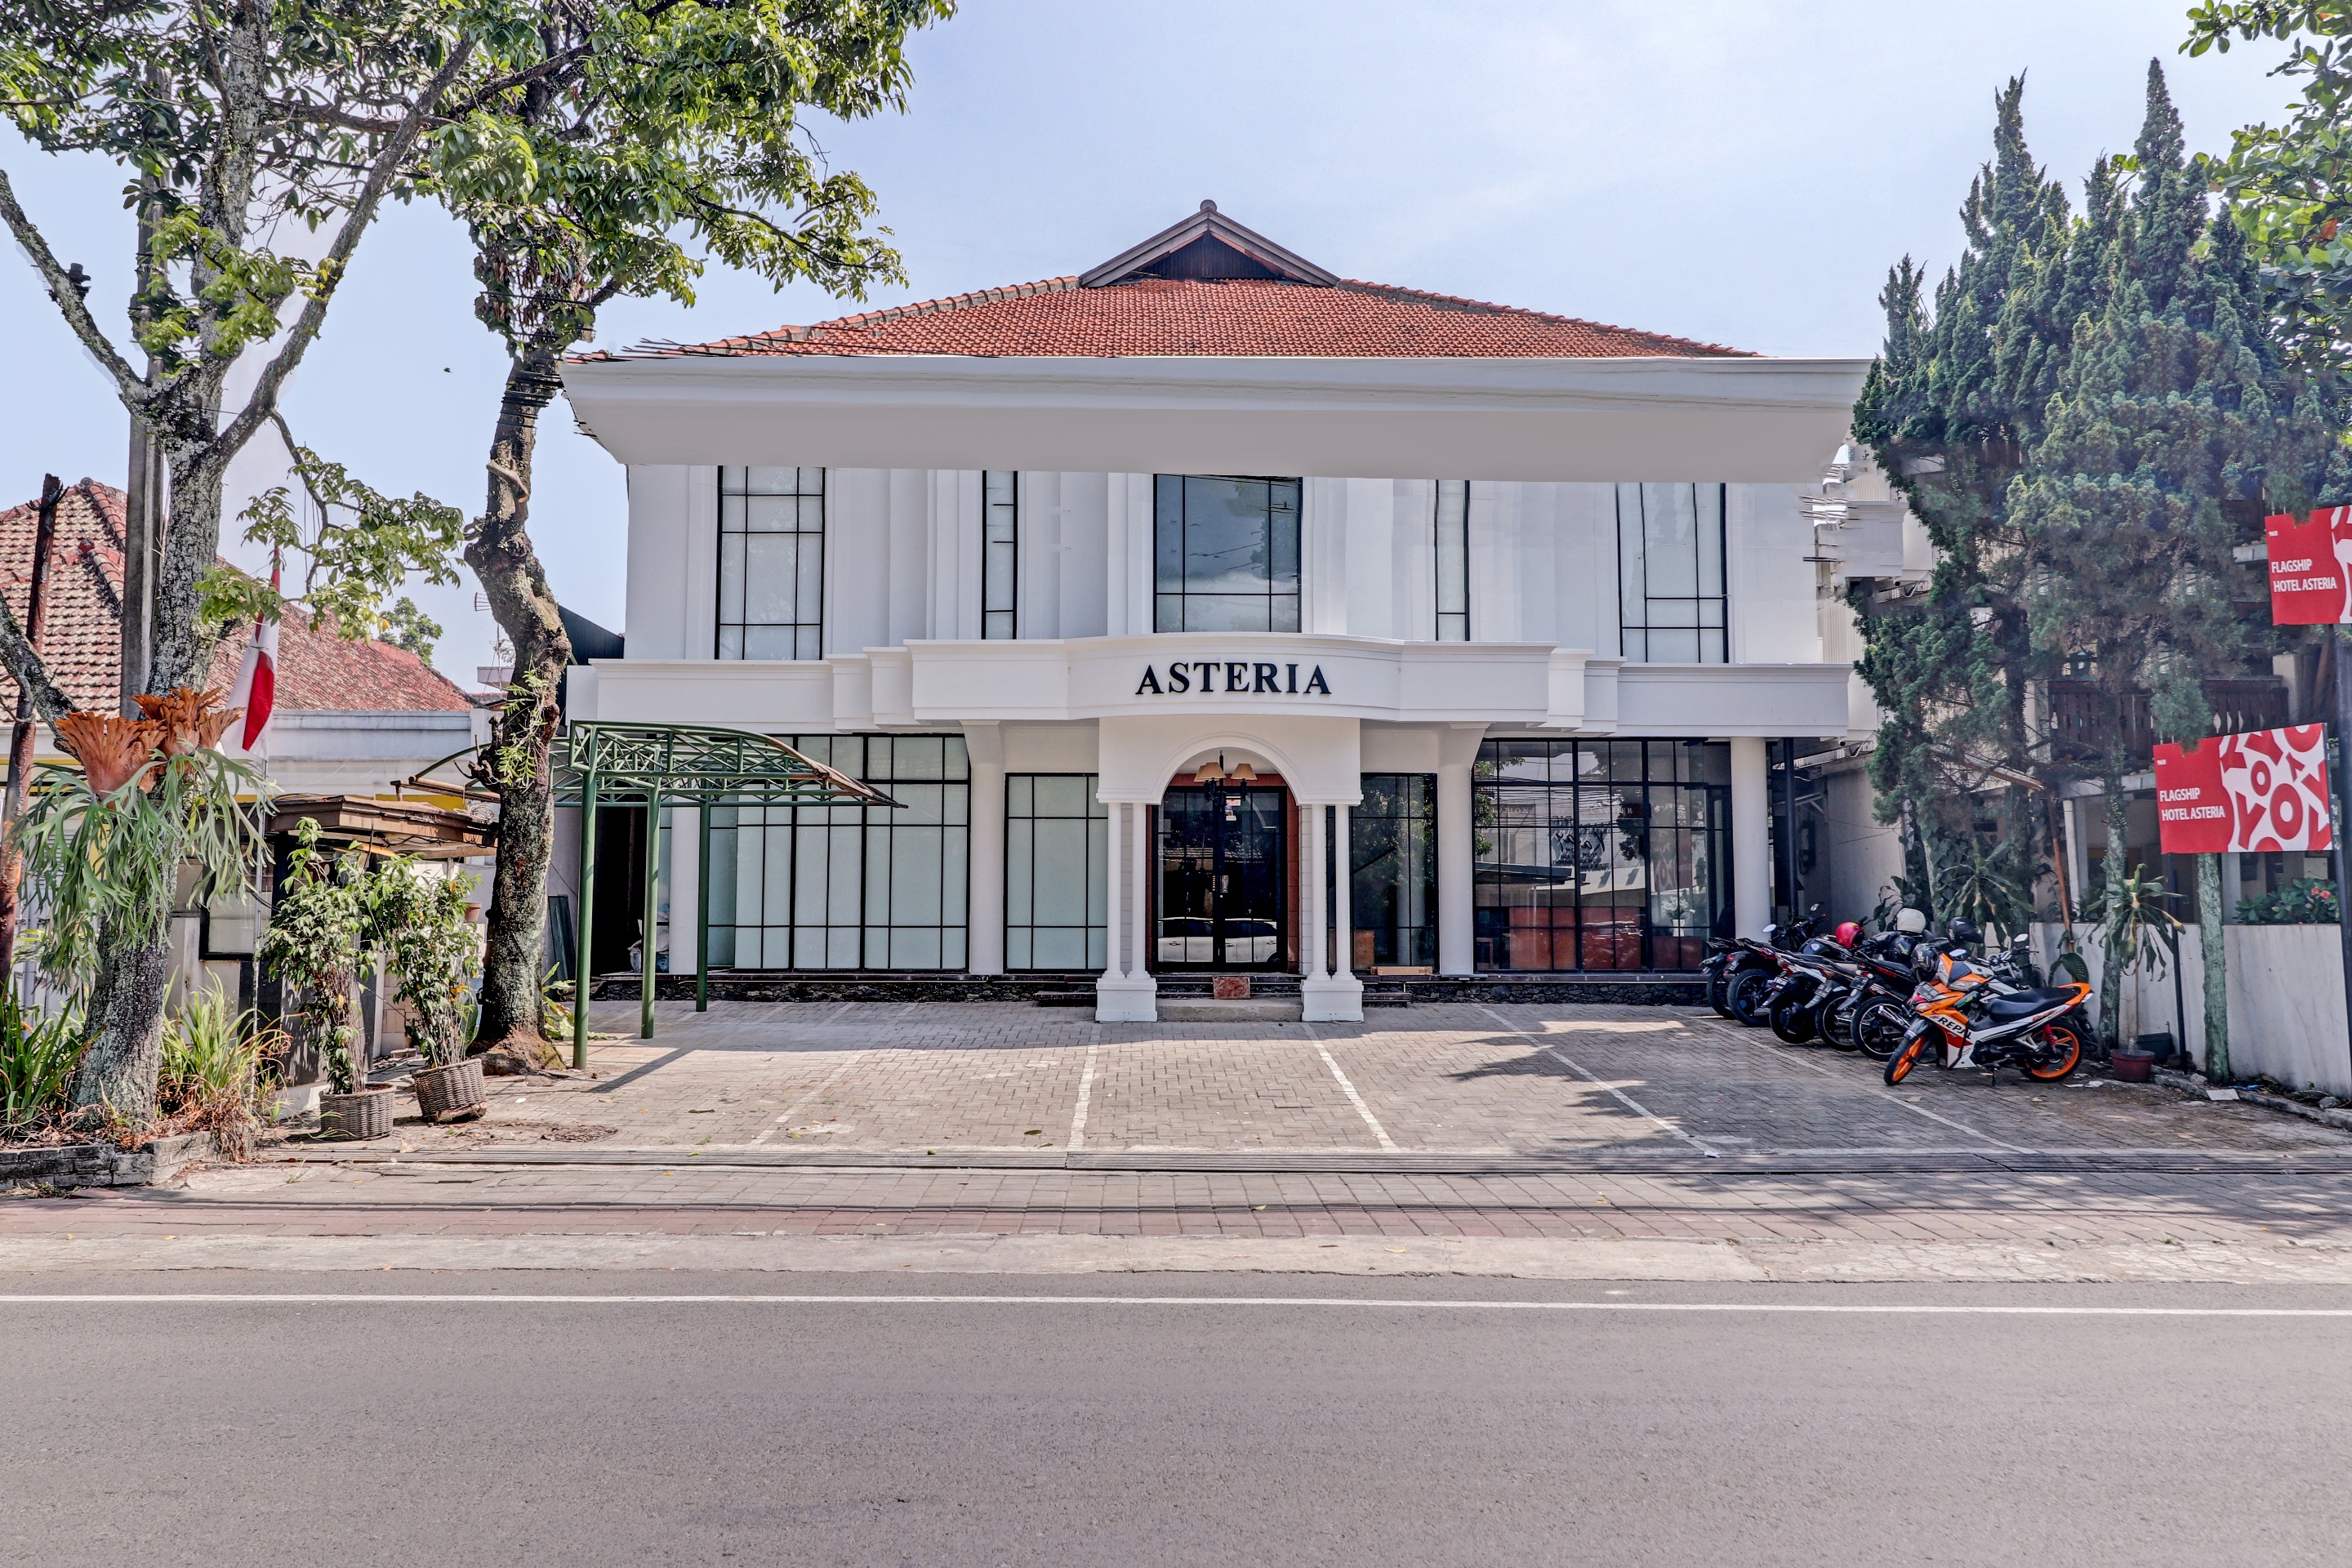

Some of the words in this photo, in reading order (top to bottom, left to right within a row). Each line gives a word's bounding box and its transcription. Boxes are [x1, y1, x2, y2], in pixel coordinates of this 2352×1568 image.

[2271, 559, 2313, 573] FLAGSHIP
[2273, 579, 2301, 593] HOTEL
[2302, 577, 2337, 590] ASTERIA
[1135, 662, 1332, 695] ASTERIA
[2159, 787, 2201, 802] FLAGSHIP
[2161, 808, 2189, 822] HOTEL
[2190, 805, 2226, 819] ASTERIA
[1938, 1017, 1971, 1040] REPL
